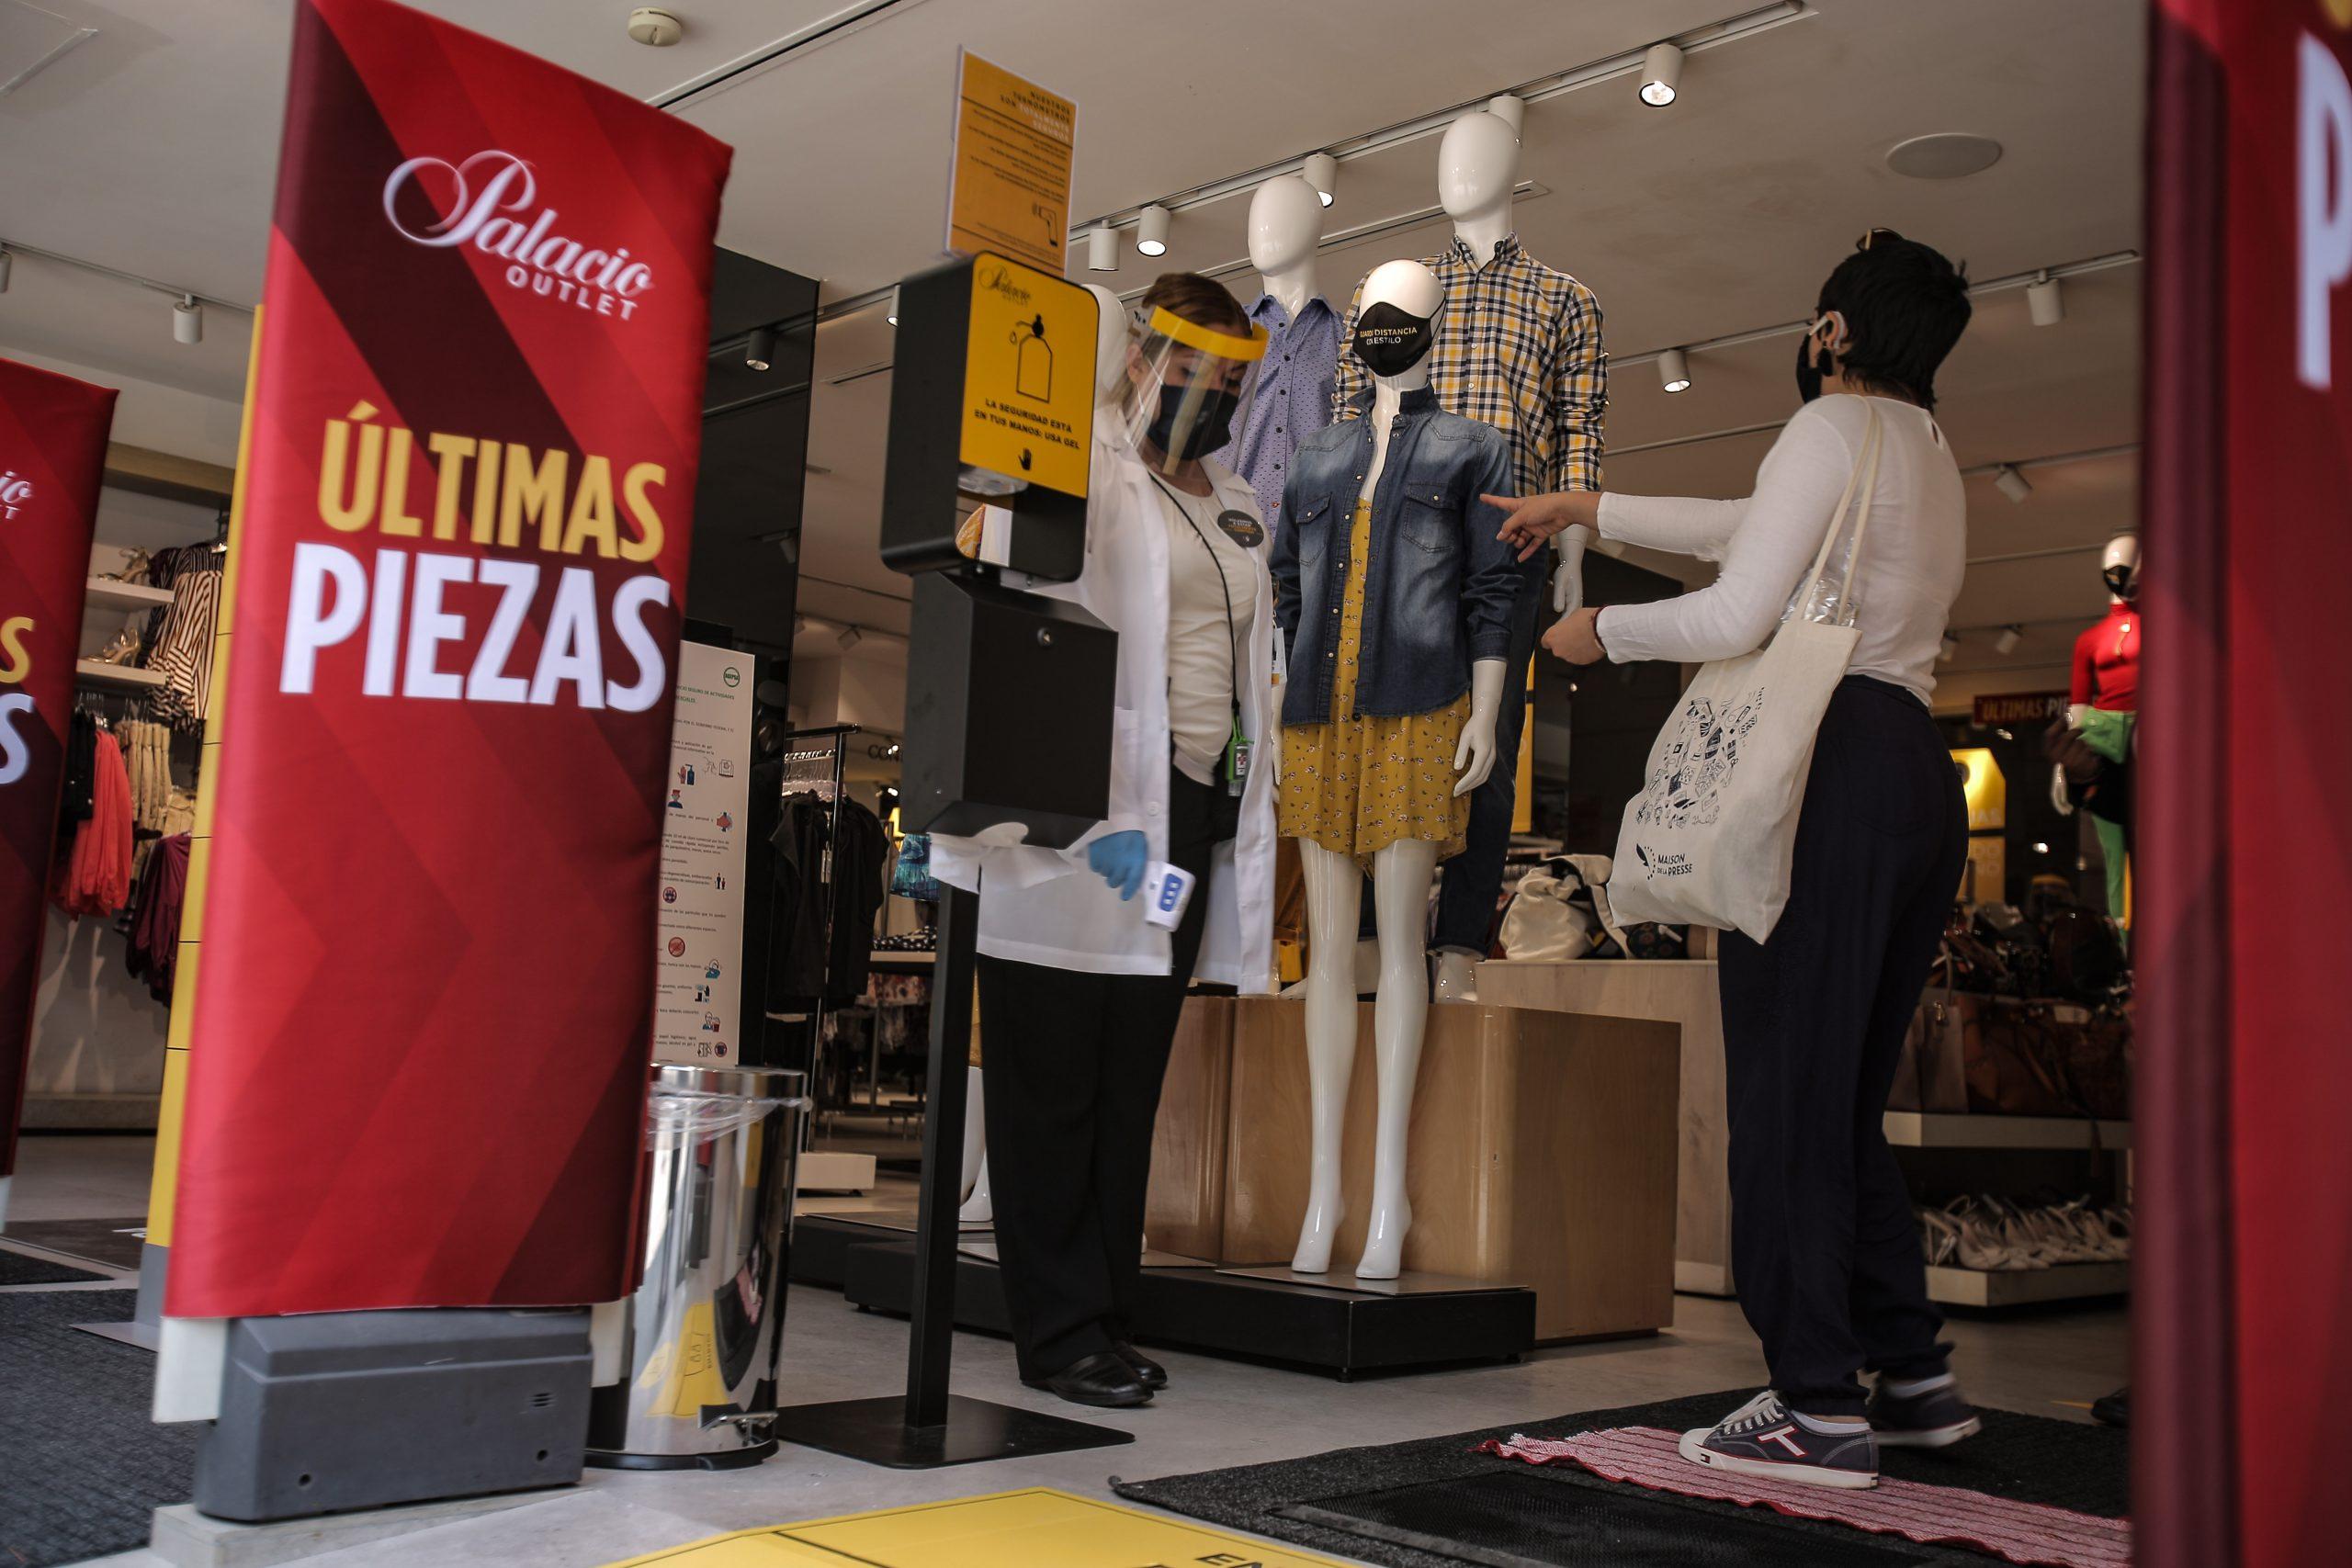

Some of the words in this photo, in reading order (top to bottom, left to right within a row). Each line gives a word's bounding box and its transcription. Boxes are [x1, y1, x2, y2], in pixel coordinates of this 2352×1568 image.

[382, 149, 655, 298] Palacio
[505, 265, 639, 321] OUTLET
[1374, 326, 1418, 336] DISTANCIA
[1374, 336, 1402, 344] ESTILO
[974, 409, 987, 420] EN
[989, 412, 1007, 426] TUS
[985, 398, 997, 409] LA
[999, 402, 1049, 424] SEGURIDAD
[317, 399, 667, 564] ÚLTIMAS
[278, 541, 671, 714] PIEZAS
[1657, 853, 1686, 864] MAISON
[1668, 863, 1692, 876] PRESSE
